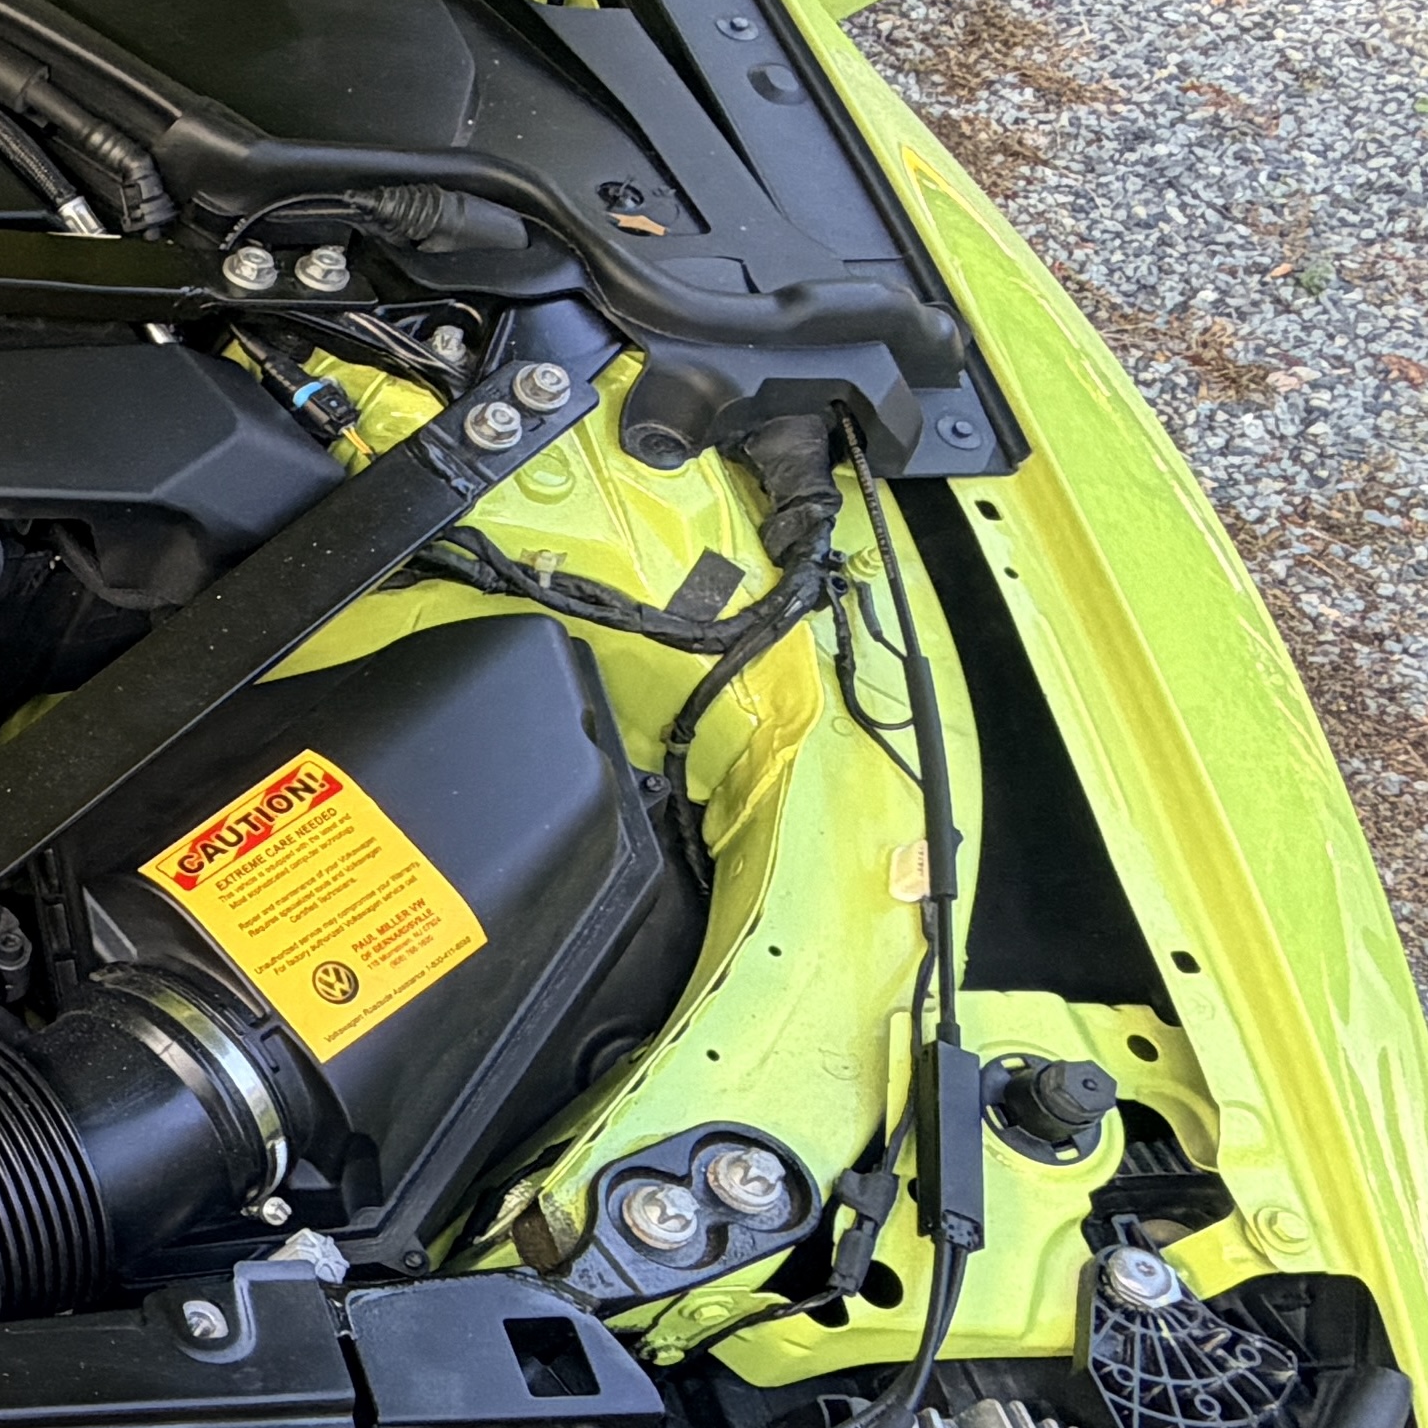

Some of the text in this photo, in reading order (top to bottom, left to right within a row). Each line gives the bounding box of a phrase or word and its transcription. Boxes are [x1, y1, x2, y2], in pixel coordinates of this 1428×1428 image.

[178, 773, 324, 873] CAUTION!
[215, 807, 337, 891] EXTREME CARE NEEDED
[261, 903, 275, 915] and
[351, 897, 425, 952] PAUL MILLER VW
